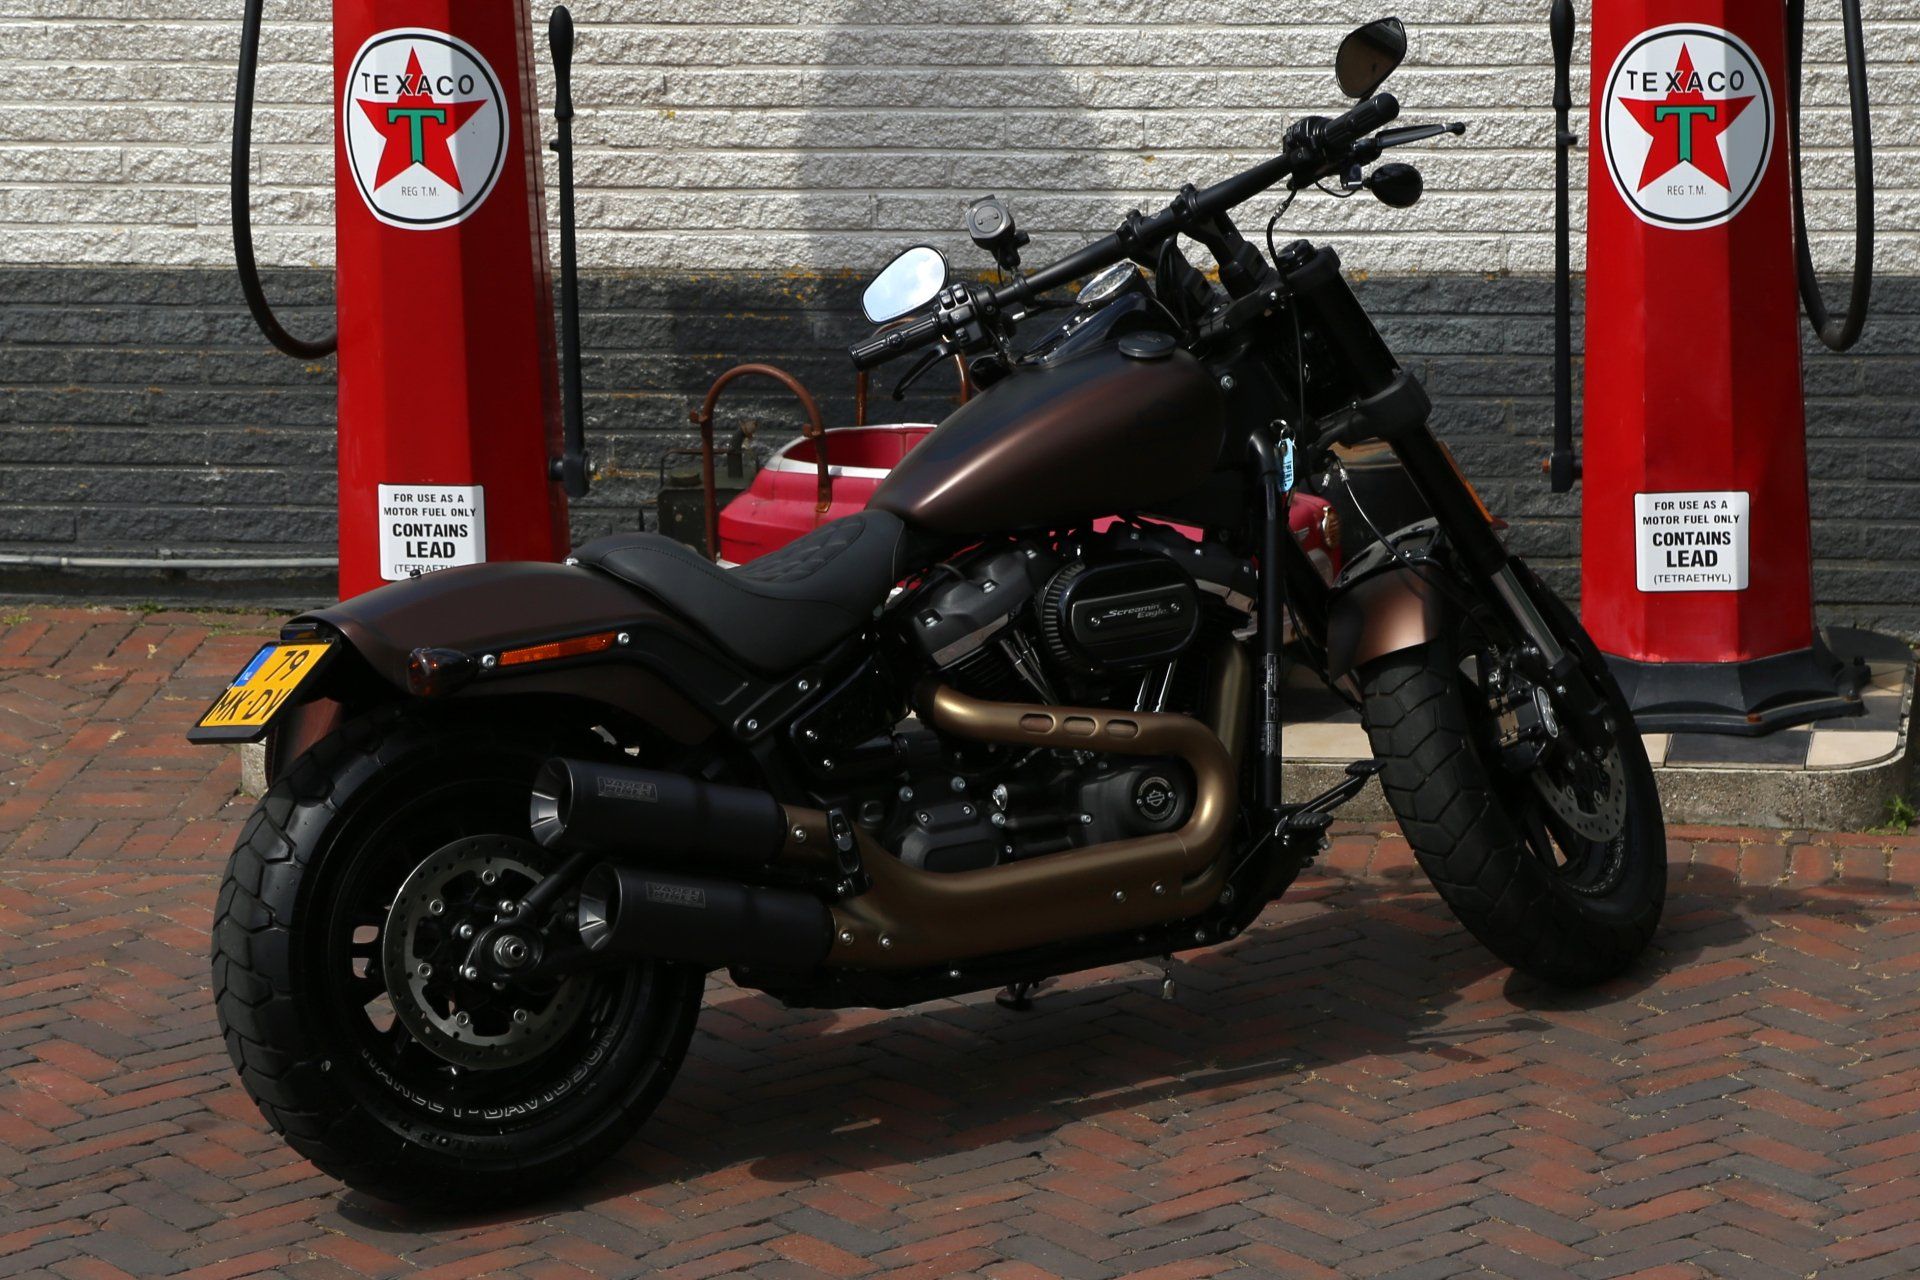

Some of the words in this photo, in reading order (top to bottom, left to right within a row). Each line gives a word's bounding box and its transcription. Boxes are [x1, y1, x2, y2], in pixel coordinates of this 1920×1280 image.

[361, 72, 475, 96] TEXACO
[1626, 70, 1745, 92] TEXACO
[387, 108, 447, 165] T
[1654, 105, 1717, 163] T
[401, 186, 418, 197] REG
[1667, 185, 1684, 196] REG
[394, 493, 414, 503] FOR
[417, 493, 437, 503] USE
[440, 494, 454, 503] AS
[457, 494, 464, 503] A
[1654, 501, 1675, 511] FOR
[1679, 500, 1699, 510] USE
[1703, 500, 1717, 509] AS
[1721, 500, 1728, 509] A
[383, 507, 419, 516] MOTOR
[422, 507, 447, 517] FUEL
[451, 508, 476, 517] ONLY
[1642, 515, 1680, 525] MOTOR
[1684, 515, 1709, 524] FUEL
[1714, 514, 1740, 524] ONLY
[392, 523, 468, 538] CONTAINS
[1652, 531, 1731, 547] CONTAINS
[406, 541, 456, 558] LEAD
[1666, 550, 1718, 568] LEAD
[1654, 573, 1732, 585] (TETRAETHYL)
[264, 650, 310, 682] 79
